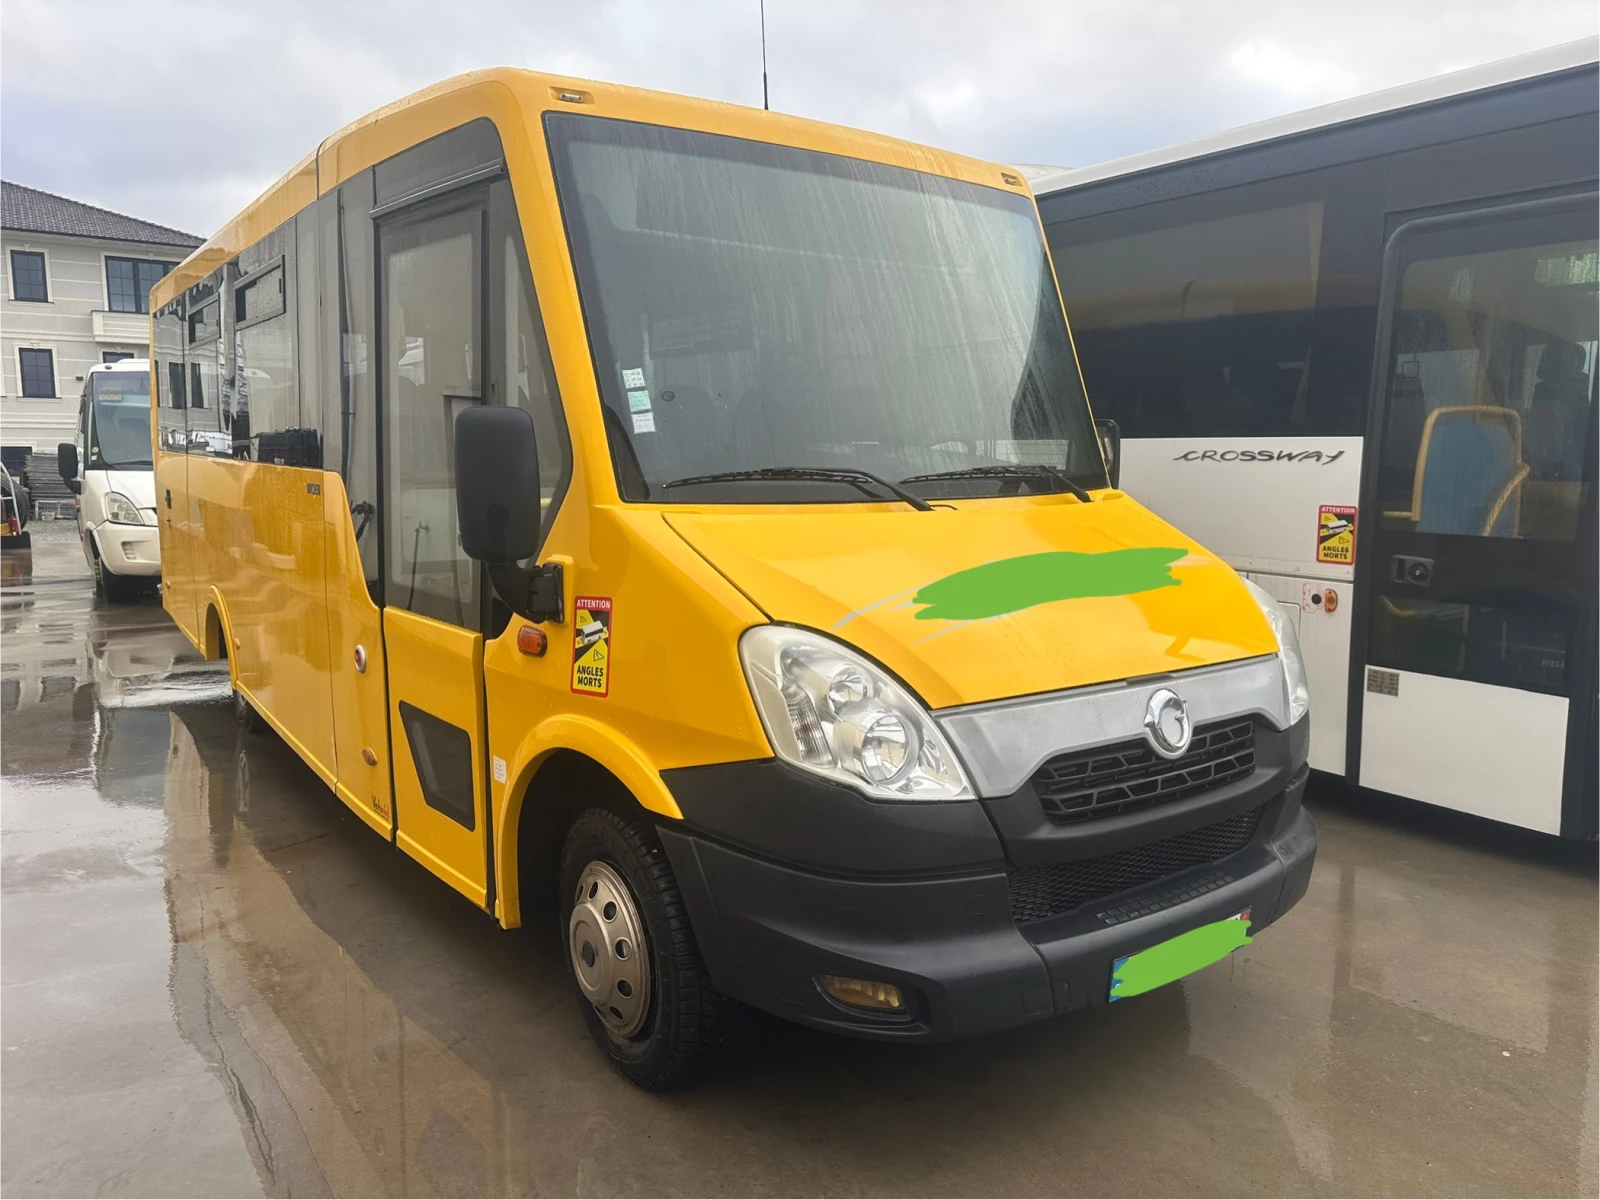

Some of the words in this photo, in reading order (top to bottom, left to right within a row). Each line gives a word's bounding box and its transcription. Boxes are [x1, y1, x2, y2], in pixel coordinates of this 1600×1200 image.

[1173, 450, 1345, 465] CROSSWAY
[1323, 552, 1348, 560] MORTS
[576, 599, 610, 609] ATTENTION
[576, 665, 604, 677] ANGLES
[577, 676, 602, 688] MORTS
